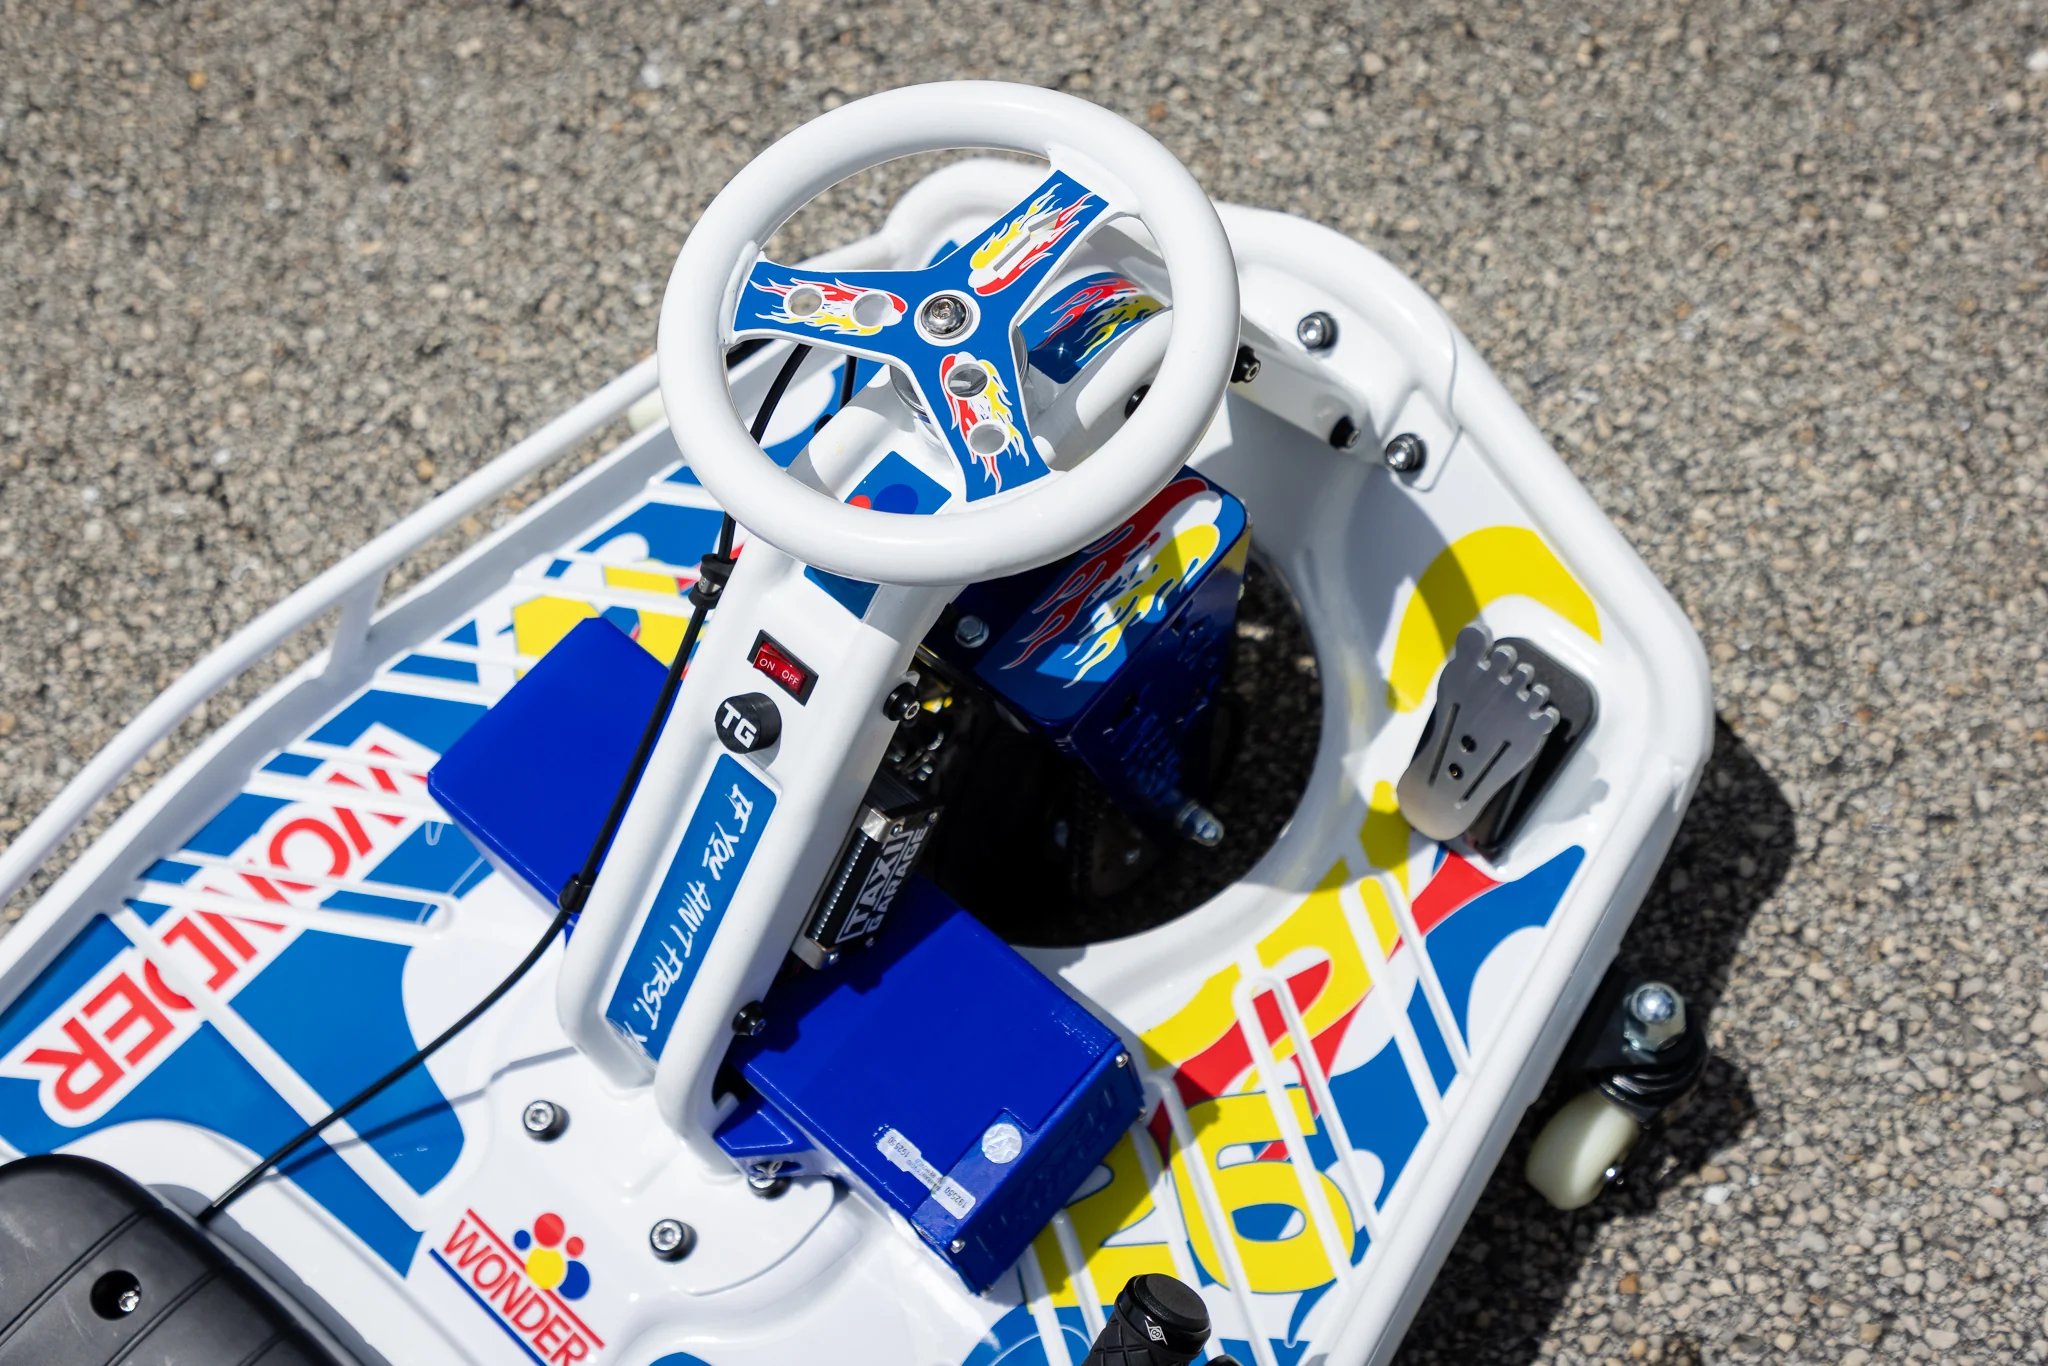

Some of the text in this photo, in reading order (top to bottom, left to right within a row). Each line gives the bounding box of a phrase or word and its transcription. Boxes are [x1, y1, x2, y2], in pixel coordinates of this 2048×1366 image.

[759, 658, 775, 671] ON
[781, 670, 799, 686] OFF
[722, 701, 758, 749] TG
[725, 784, 754, 834] IF
[702, 821, 740, 881] YOU
[866, 826, 929, 933] GARAGE
[843, 842, 905, 935] TAXI
[23, 743, 428, 1112] WONDER
[443, 1218, 590, 1366] WONDER
